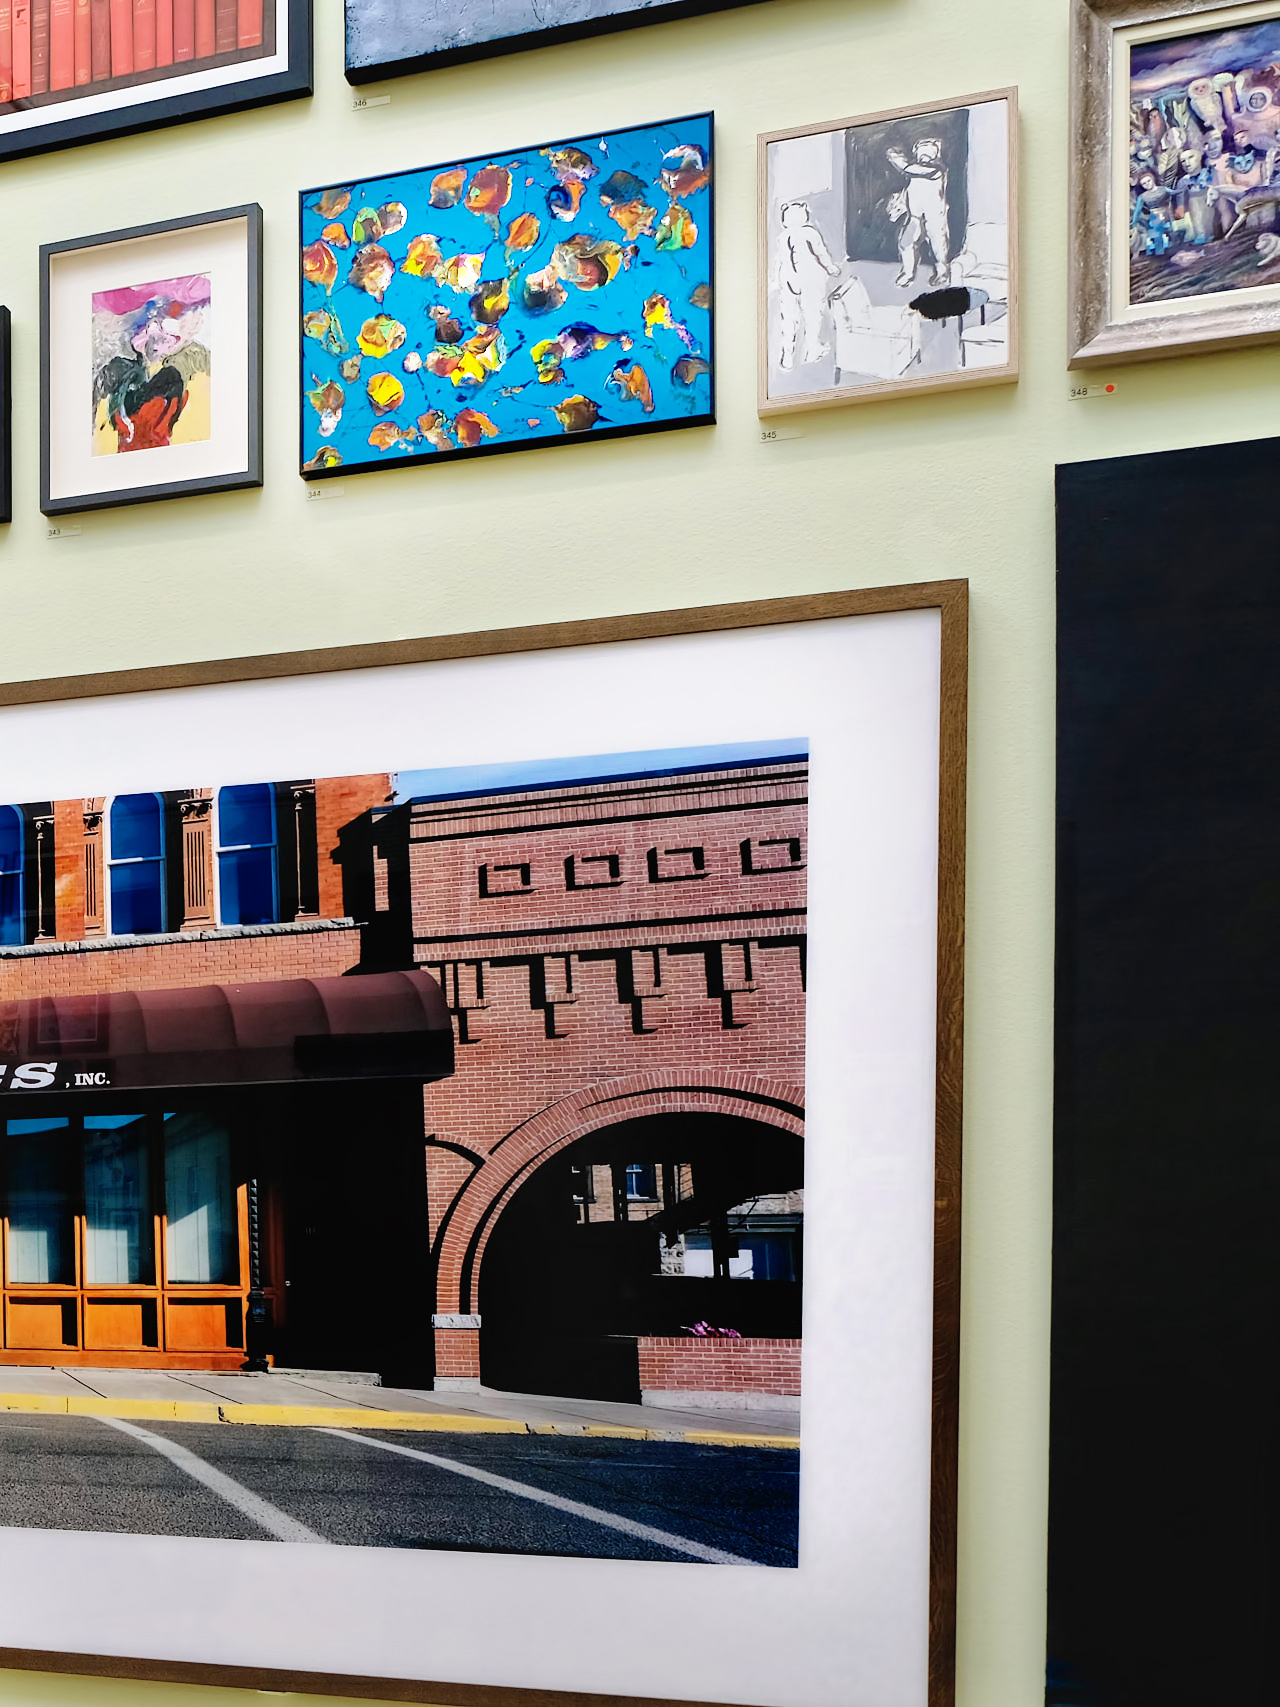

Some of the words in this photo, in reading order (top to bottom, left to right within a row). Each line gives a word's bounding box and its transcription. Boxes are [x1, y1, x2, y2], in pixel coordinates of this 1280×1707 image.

[353, 100, 367, 108] 346
[1070, 388, 1088, 397] 348
[761, 431, 777, 440] 345
[307, 490, 321, 499] 344
[48, 528, 61, 537] 343
[74, 1072, 111, 1086] INC.
